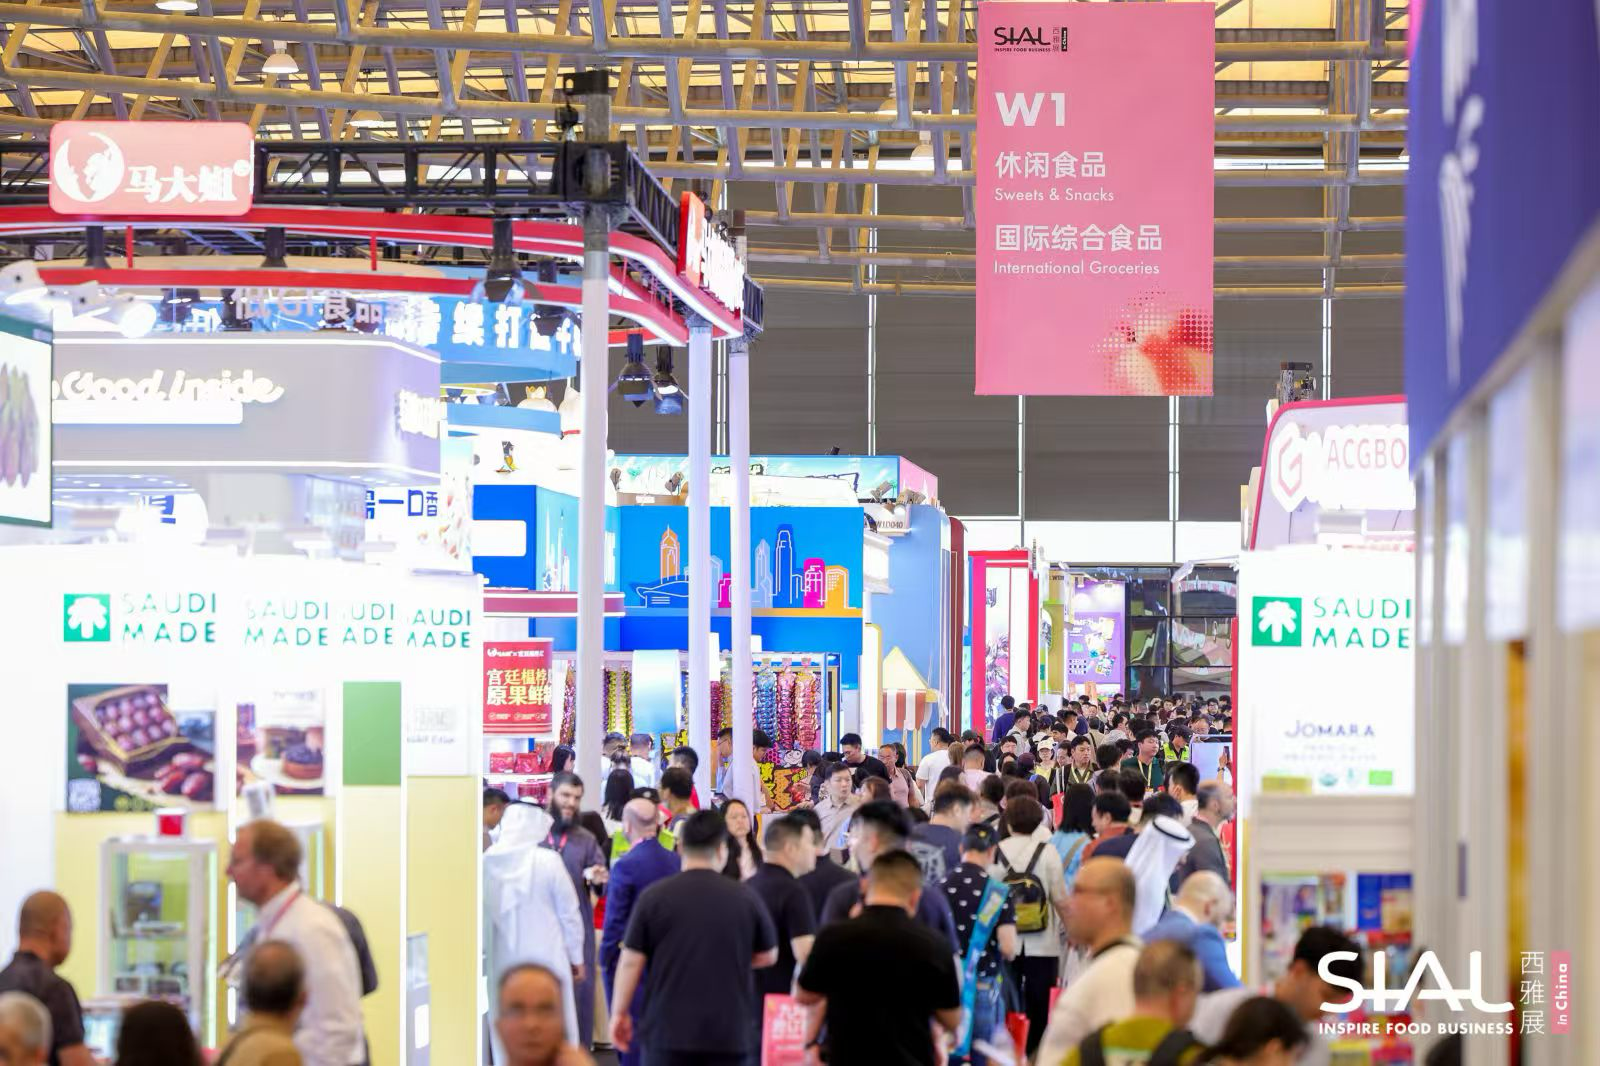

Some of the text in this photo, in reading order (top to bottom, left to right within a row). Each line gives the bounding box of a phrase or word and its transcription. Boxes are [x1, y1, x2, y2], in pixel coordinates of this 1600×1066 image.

[994, 26, 1051, 46] SIAL
[995, 92, 1066, 127] W1
[995, 151, 1107, 178] 休闲食品
[994, 188, 1114, 201] Sweets & Snacks
[995, 224, 1163, 252] 国际综合食品
[994, 260, 1160, 274] International Groceries
[122, 592, 216, 614] SAUDI
[1313, 597, 1411, 619] SAUDI
[122, 622, 216, 644] MADE
[244, 627, 328, 647] MADE
[1312, 627, 1410, 648] MADE
